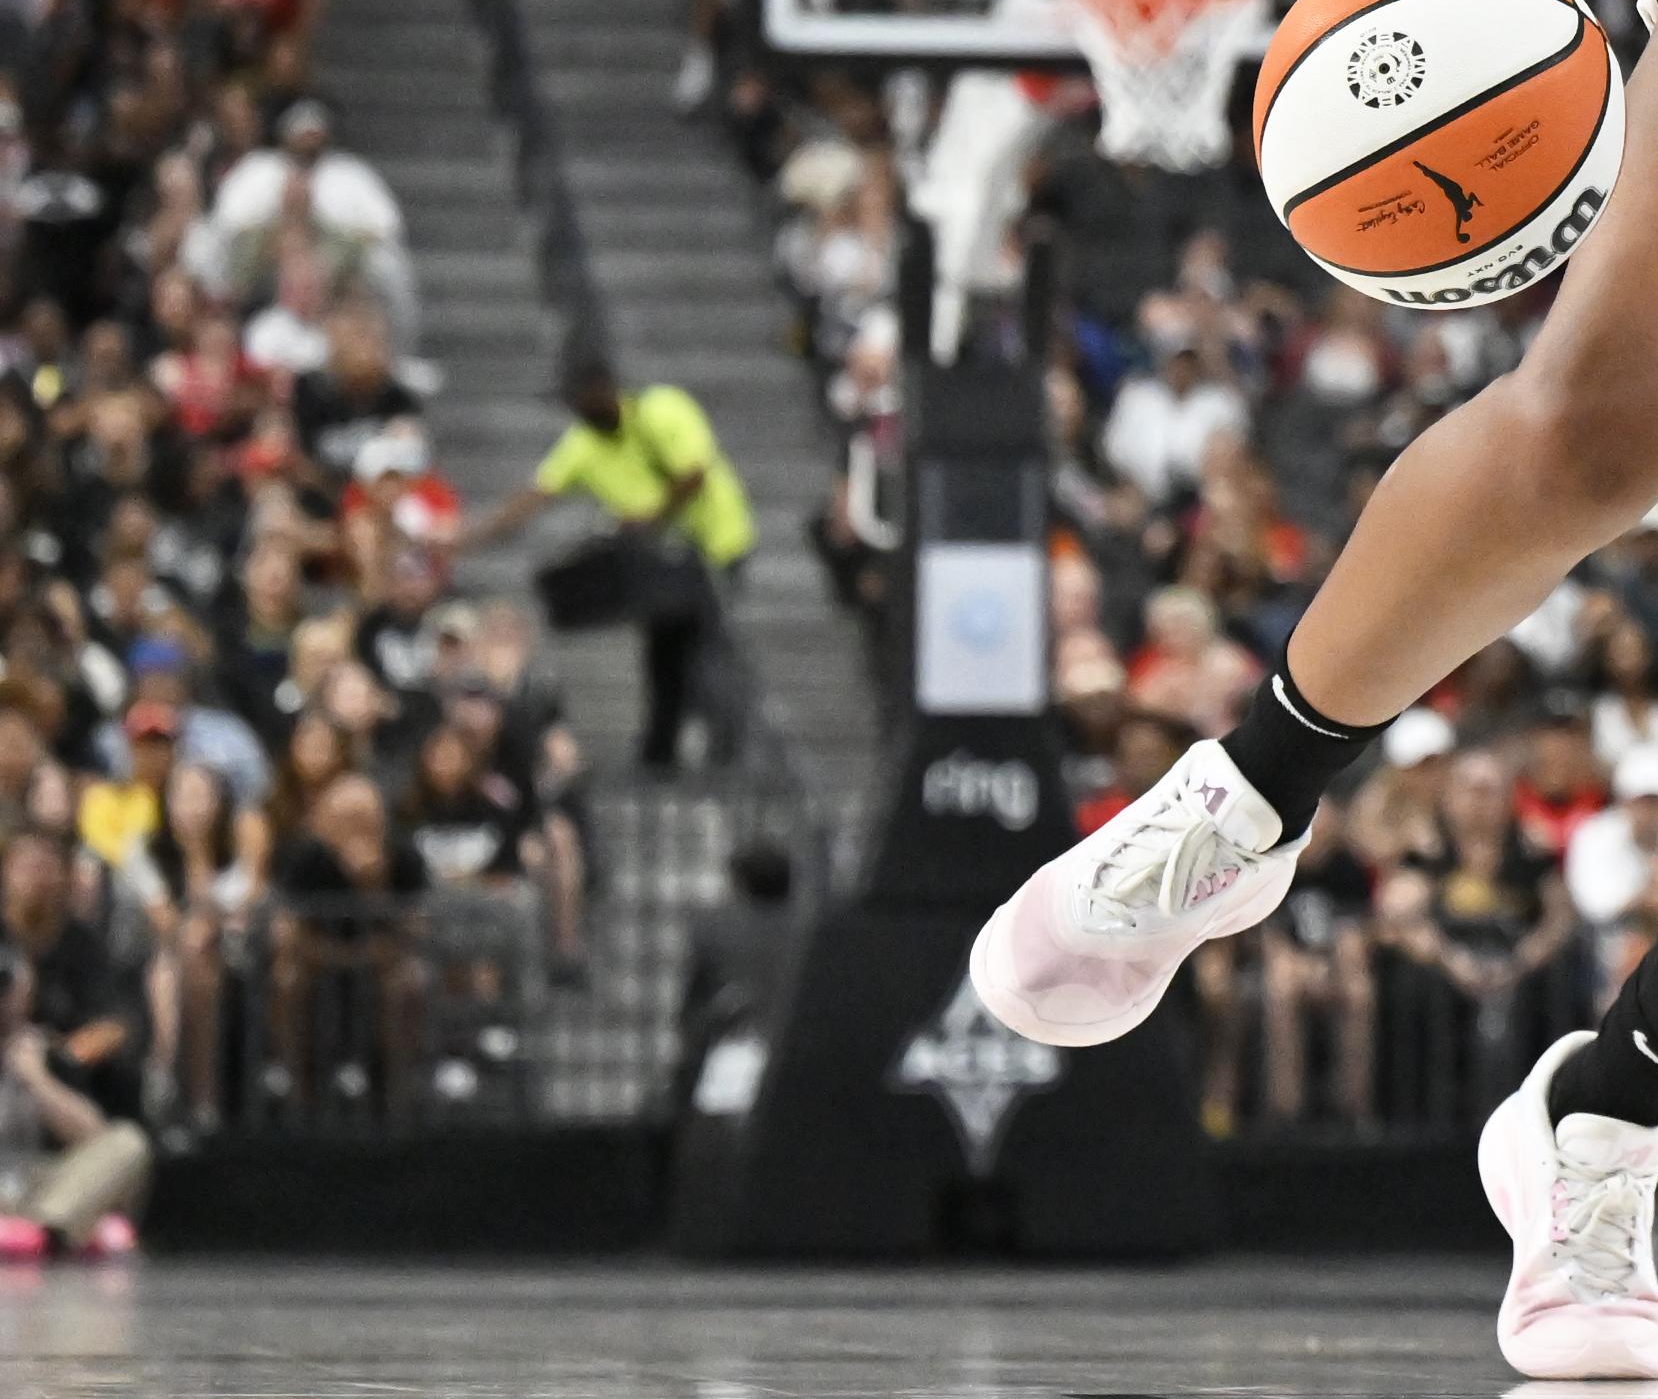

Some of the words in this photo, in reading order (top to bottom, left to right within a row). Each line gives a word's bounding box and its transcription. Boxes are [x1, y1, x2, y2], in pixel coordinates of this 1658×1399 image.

[1506, 120, 1540, 149] GAME
[1473, 145, 1507, 168] BALL
[1499, 244, 1524, 262] EVO
[1466, 261, 1495, 278] NXT
